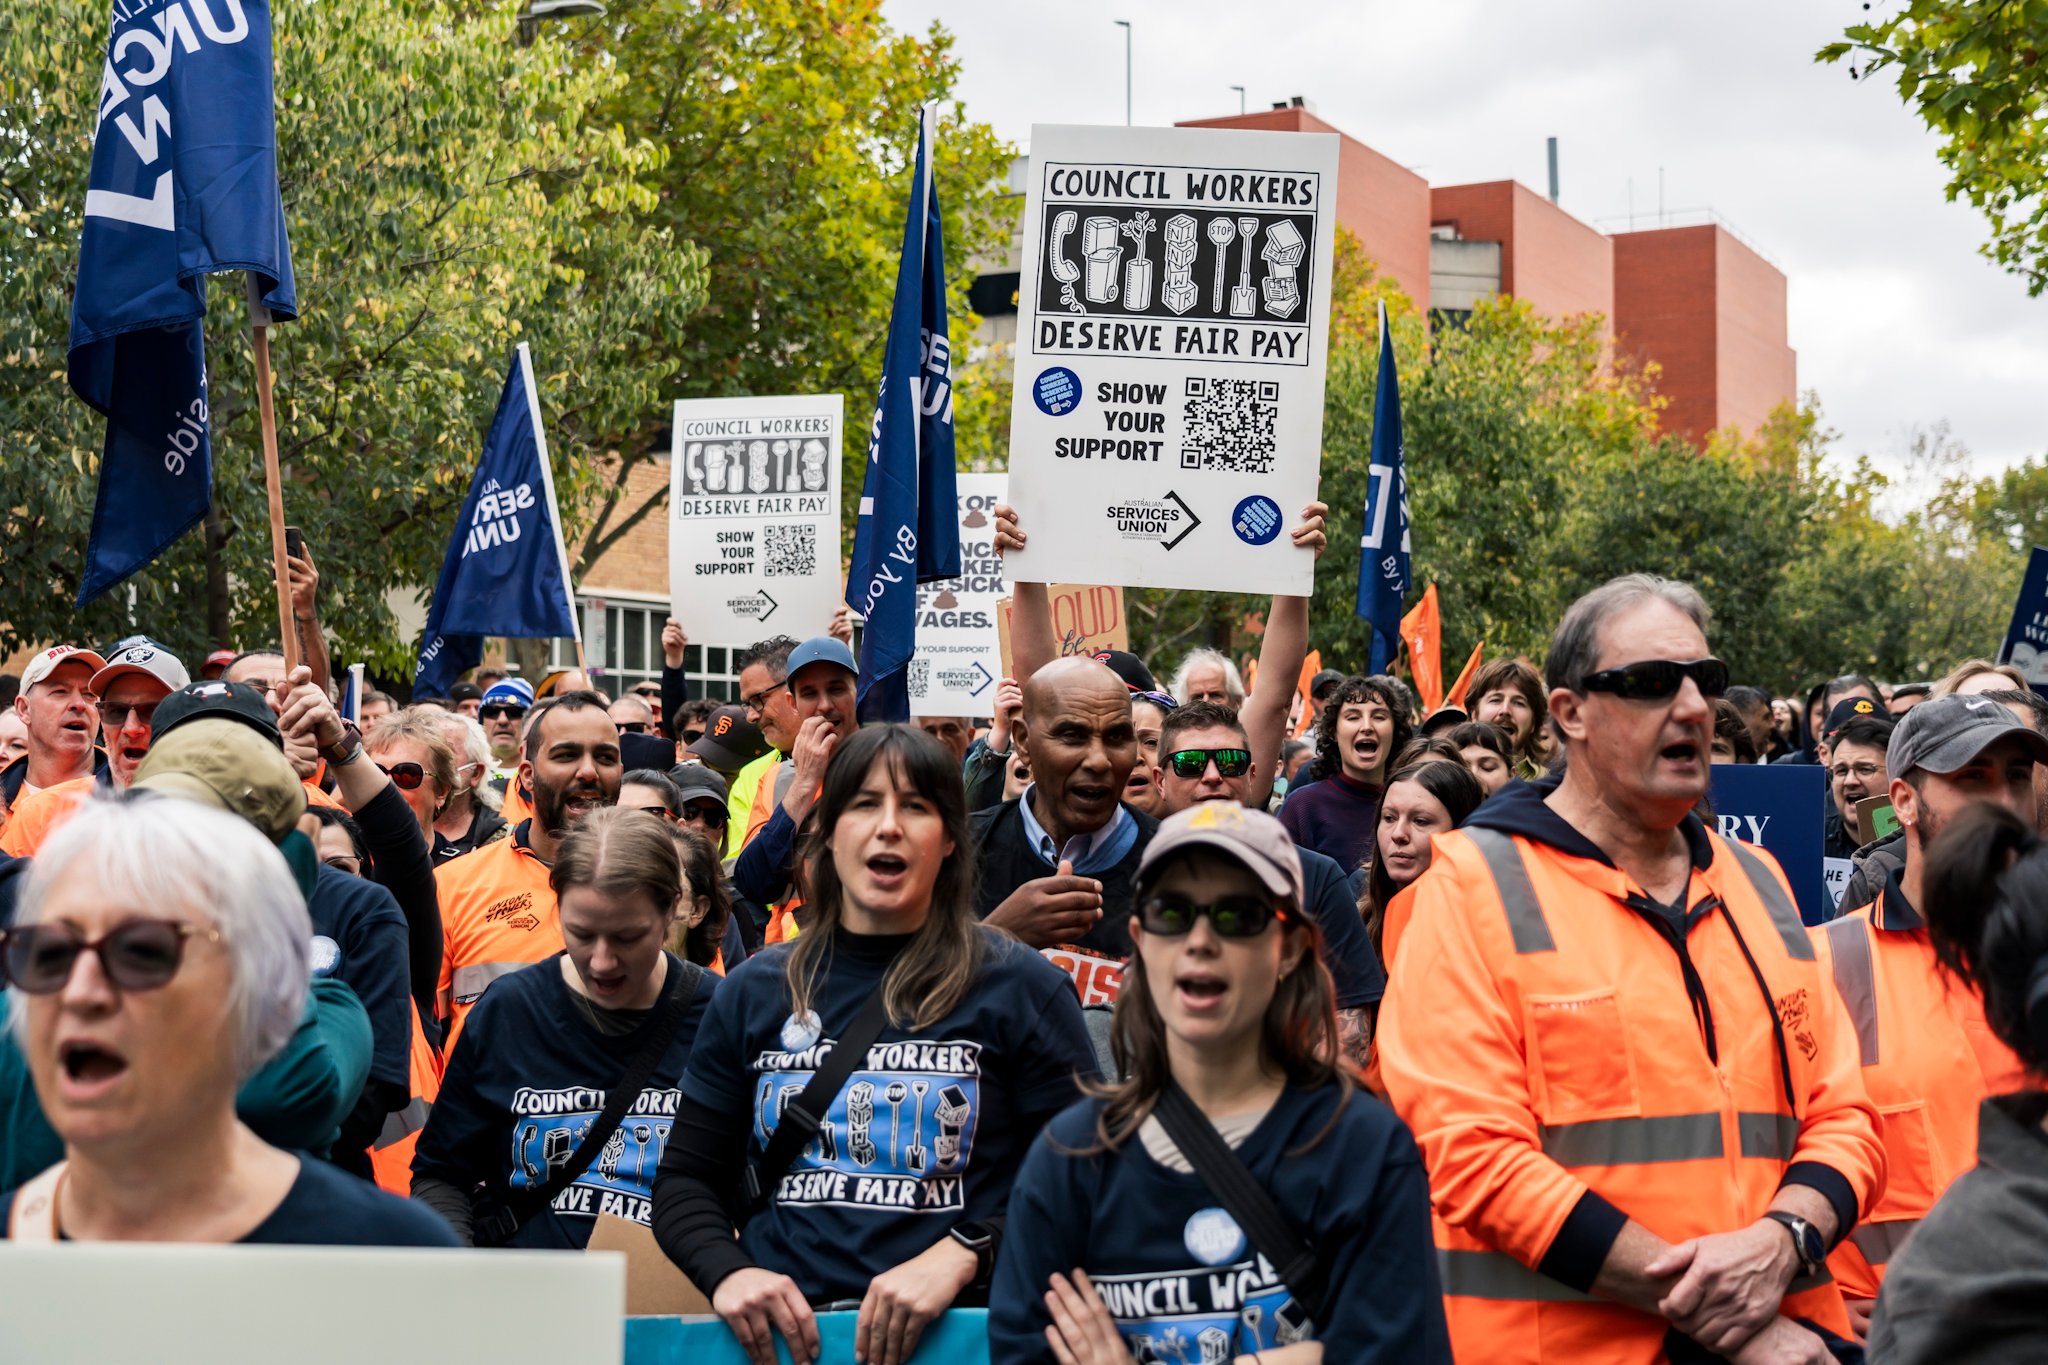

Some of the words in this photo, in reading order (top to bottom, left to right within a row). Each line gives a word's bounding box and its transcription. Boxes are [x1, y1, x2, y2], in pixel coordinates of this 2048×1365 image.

[1050, 169, 1170, 200] COUNCIL
[1187, 173, 1312, 206] WORKERS
[1211, 225, 1232, 236] STOP
[1040, 321, 1162, 352] DESERVE
[1175, 326, 1239, 355] FAIR
[1251, 330, 1303, 358] PAY
[1097, 382, 1167, 405] SHOW
[686, 420, 752, 436] COUNCIL
[761, 419, 829, 433] WORKERS
[1104, 411, 1165, 433] YOUR
[1055, 437, 1164, 461] SUPPORT
[683, 499, 750, 516] DESERVE
[757, 498, 792, 513] FAIR
[799, 497, 827, 512] PAY
[1106, 506, 1180, 521] SERVICES
[1123, 499, 1163, 508] AUSTRALIAN
[1117, 519, 1167, 533] UNION
[716, 531, 754, 543] SHOW
[721, 547, 754, 558] YOUR
[695, 562, 755, 575] SUPPORT
[948, 576, 1005, 592] SICK
[1049, 586, 1118, 642] OUD
[936, 672, 980, 680] SERVICES
[1716, 814, 1771, 847] RY
[867, 1043, 977, 1073] WORKERS
[515, 1090, 606, 1114] COUNCIL
[627, 1092, 682, 1114] ORK
[855, 1177, 917, 1207] FAIR
[922, 1178, 956, 1206] AY
[600, 1192, 652, 1221] FAIR
